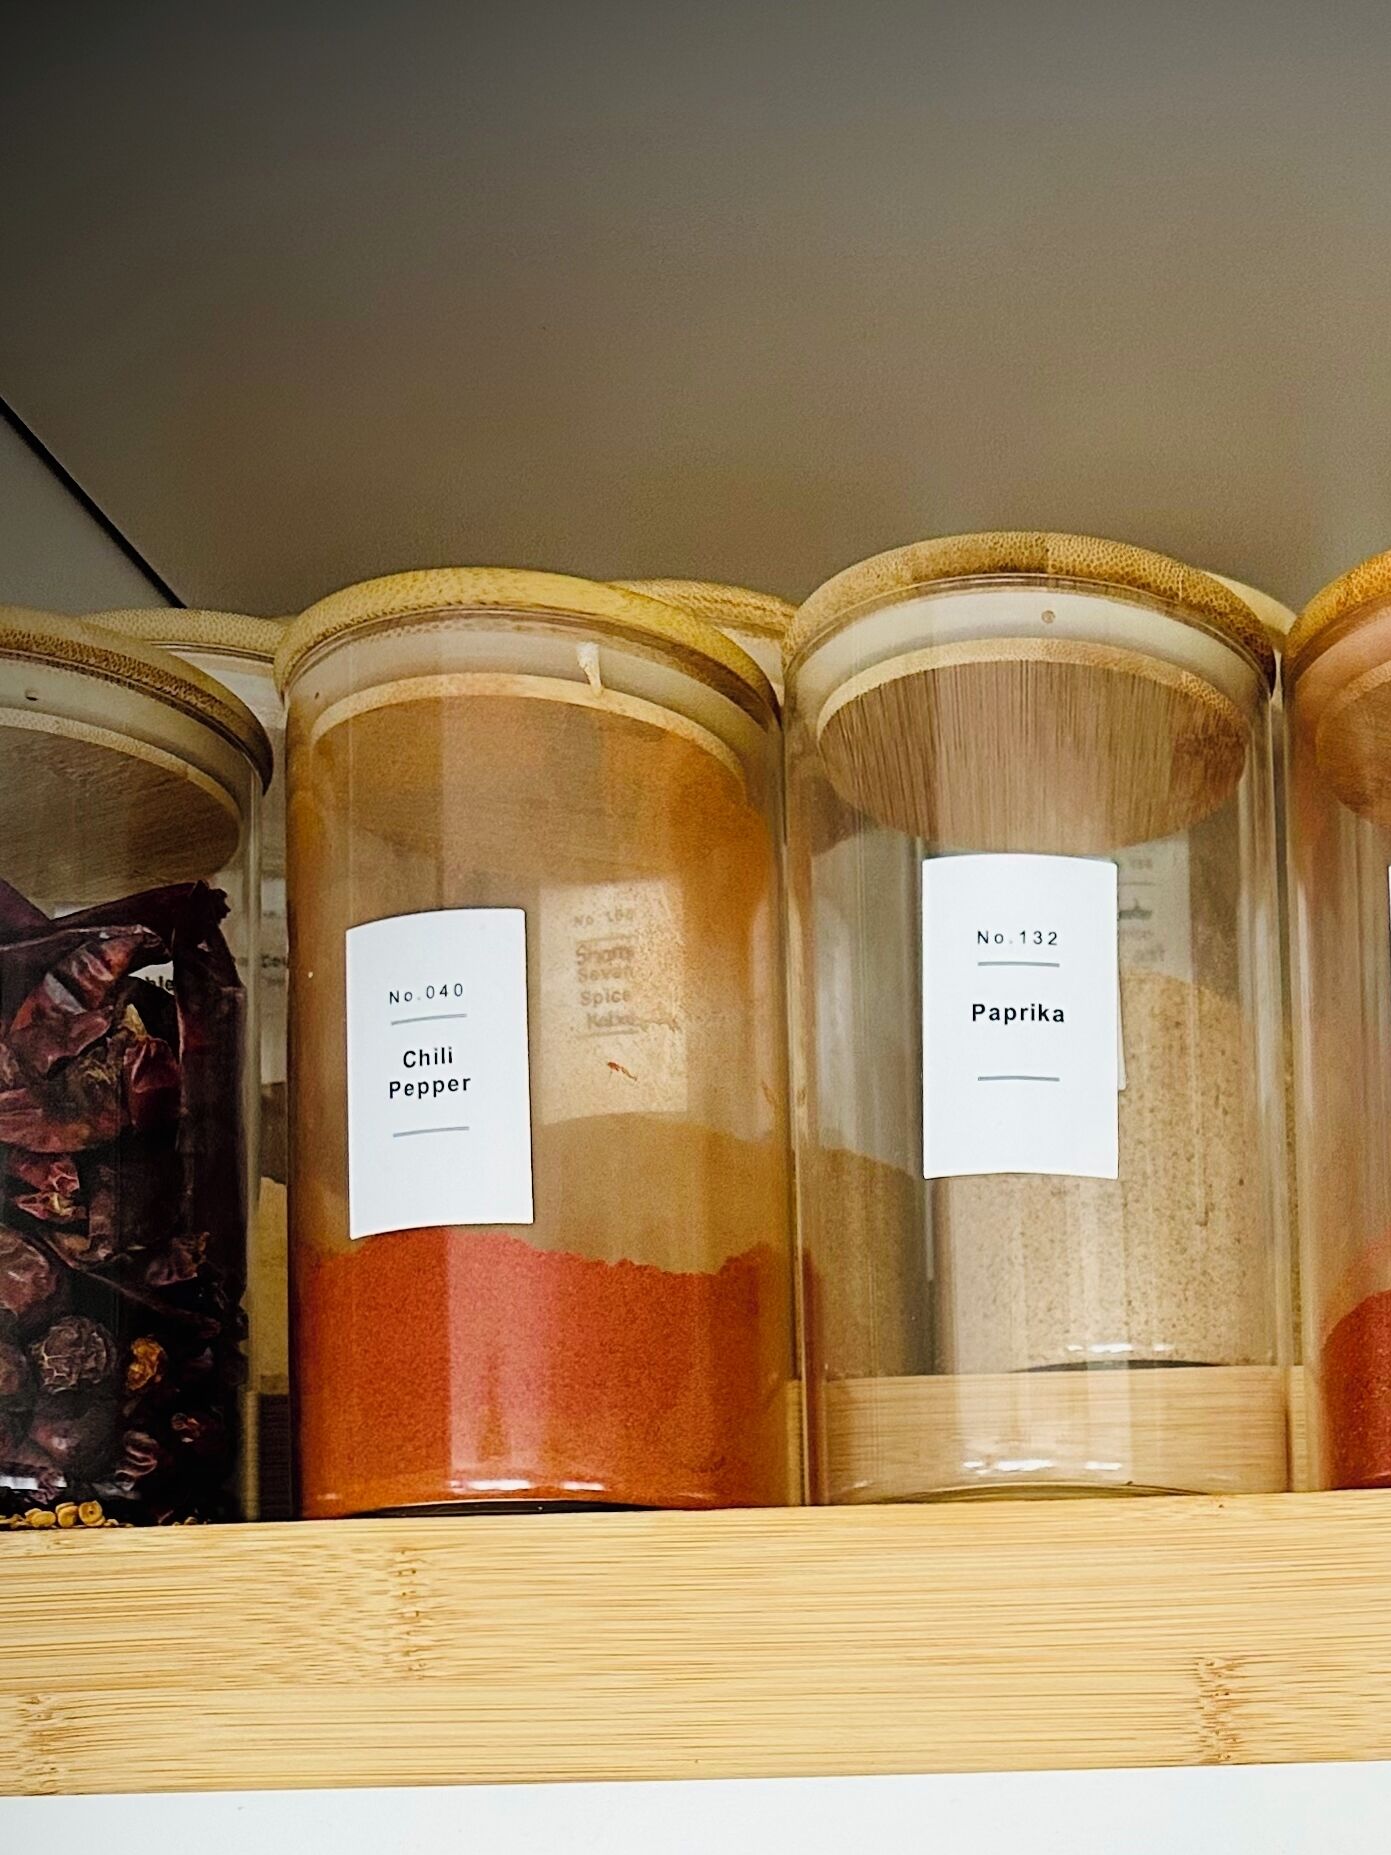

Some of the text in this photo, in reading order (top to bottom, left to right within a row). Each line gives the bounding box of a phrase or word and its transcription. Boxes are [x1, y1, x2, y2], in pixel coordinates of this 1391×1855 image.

[977, 930, 1058, 946] No.132
[389, 983, 463, 1005] No.040
[972, 1003, 1065, 1026] Paprika
[402, 1046, 453, 1069] Chili
[389, 1077, 471, 1100] Pepper
